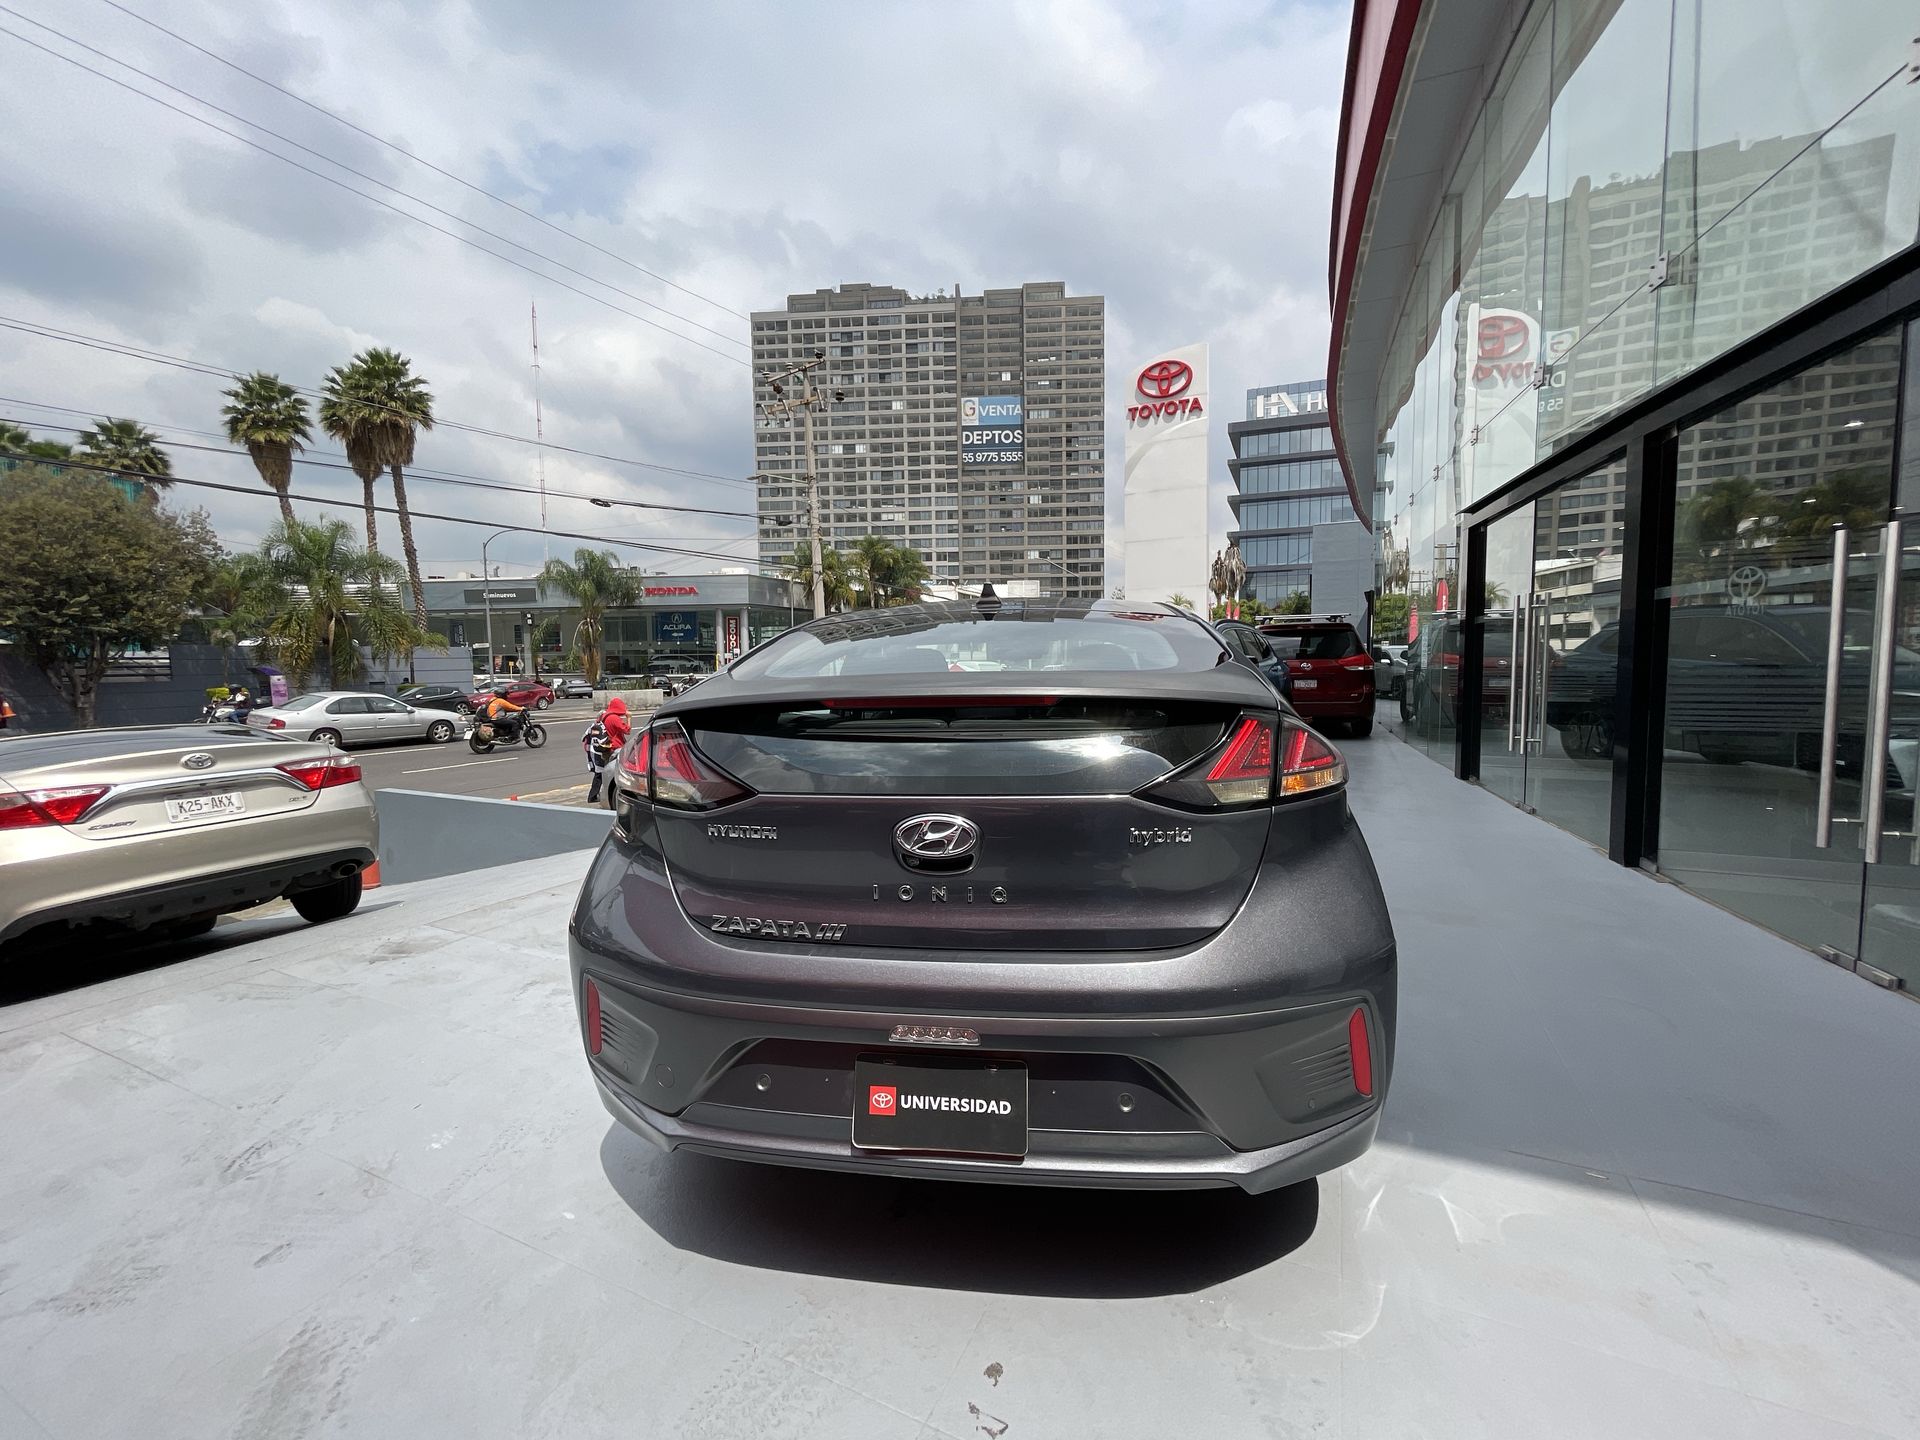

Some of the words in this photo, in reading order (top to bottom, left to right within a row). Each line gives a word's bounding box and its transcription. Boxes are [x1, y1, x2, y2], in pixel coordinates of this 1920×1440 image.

[979, 404, 1023, 416] VENTA
[1128, 397, 1203, 421] TOYOTA
[962, 430, 1023, 444] DEPTOS
[962, 452, 974, 462] 55
[976, 452, 999, 462] 9775
[1000, 451, 1023, 462] 5555
[644, 587, 698, 596] HONDA
[177, 795, 234, 814] K25-AKX
[707, 823, 777, 840] HYUNDAI
[1129, 827, 1193, 846] hybrid
[872, 884, 1008, 904] IONIQ
[711, 914, 812, 939] ZAPATA
[900, 1094, 1012, 1115] UNIVERSIDAD
